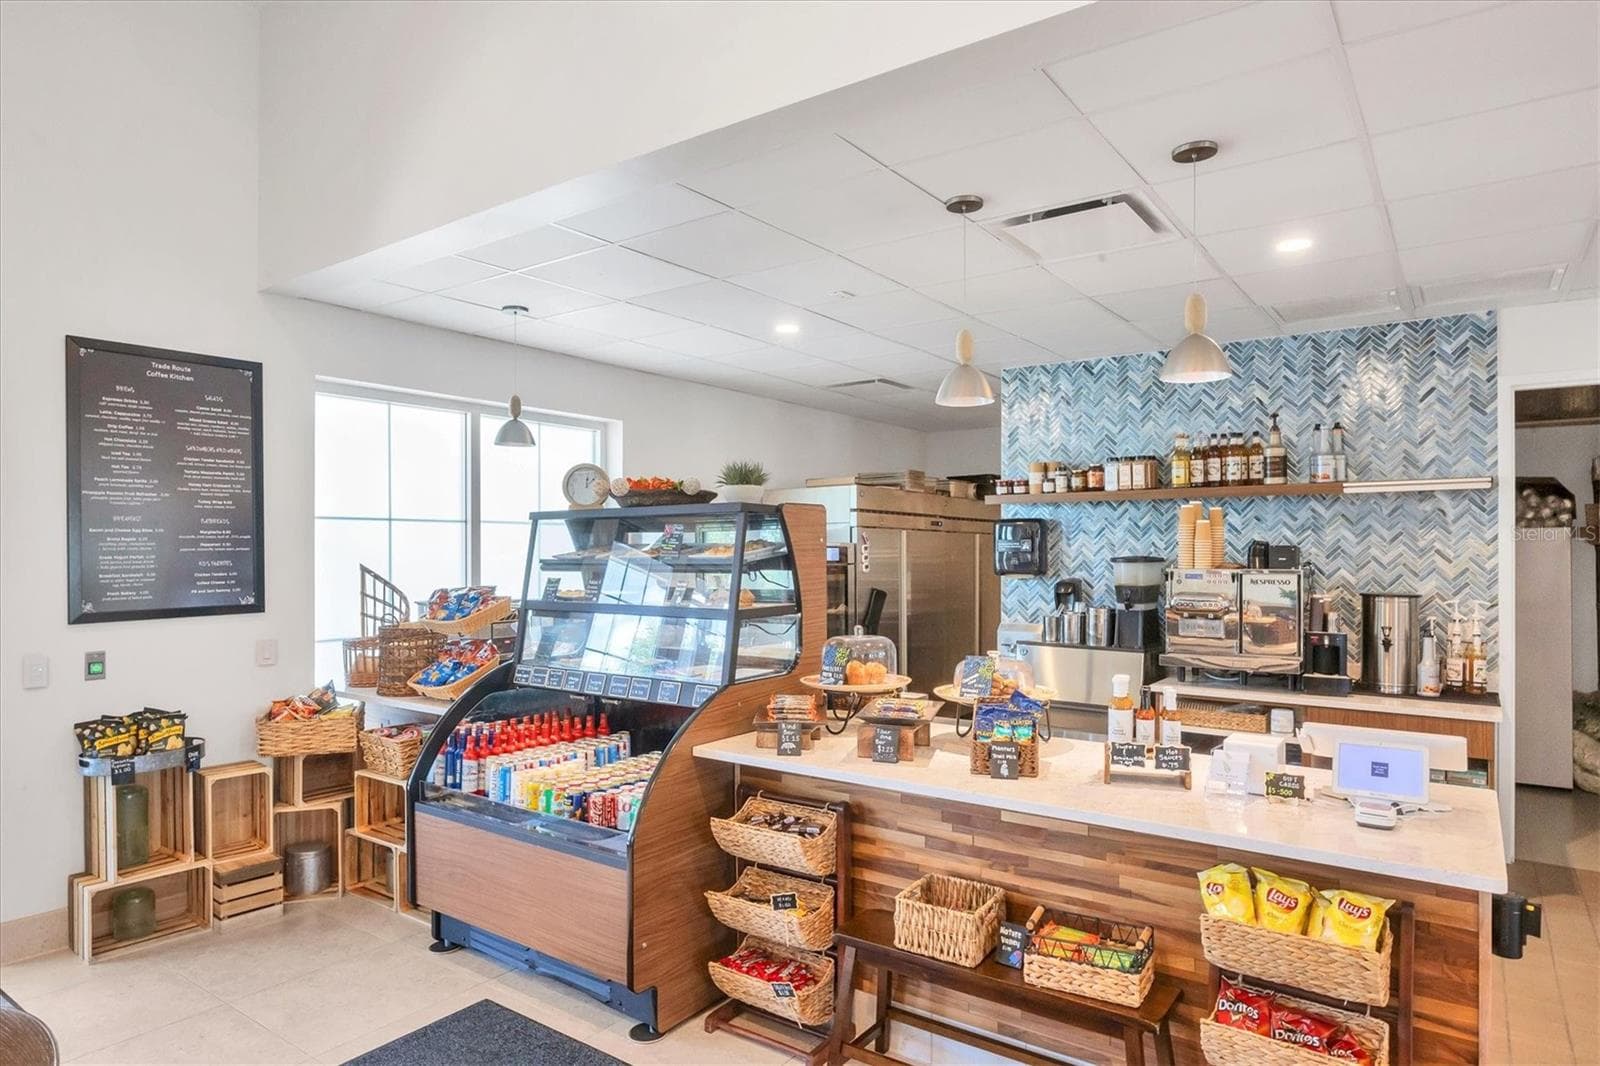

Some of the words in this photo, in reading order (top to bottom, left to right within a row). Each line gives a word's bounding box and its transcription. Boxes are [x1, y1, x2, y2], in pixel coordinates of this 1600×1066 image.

[152, 362, 170, 370] Trade
[172, 364, 191, 372] Route
[146, 370, 168, 378] Coffee
[170, 374, 194, 382] Kitchen
[1269, 889, 1297, 909] Lay's
[1340, 900, 1369, 919] Lay's
[1000, 926, 1022, 938] Nature
[1001, 936, 1021, 948] Valley
[1219, 999, 1259, 1019] Doritos
[1275, 1029, 1320, 1046] Doritos
